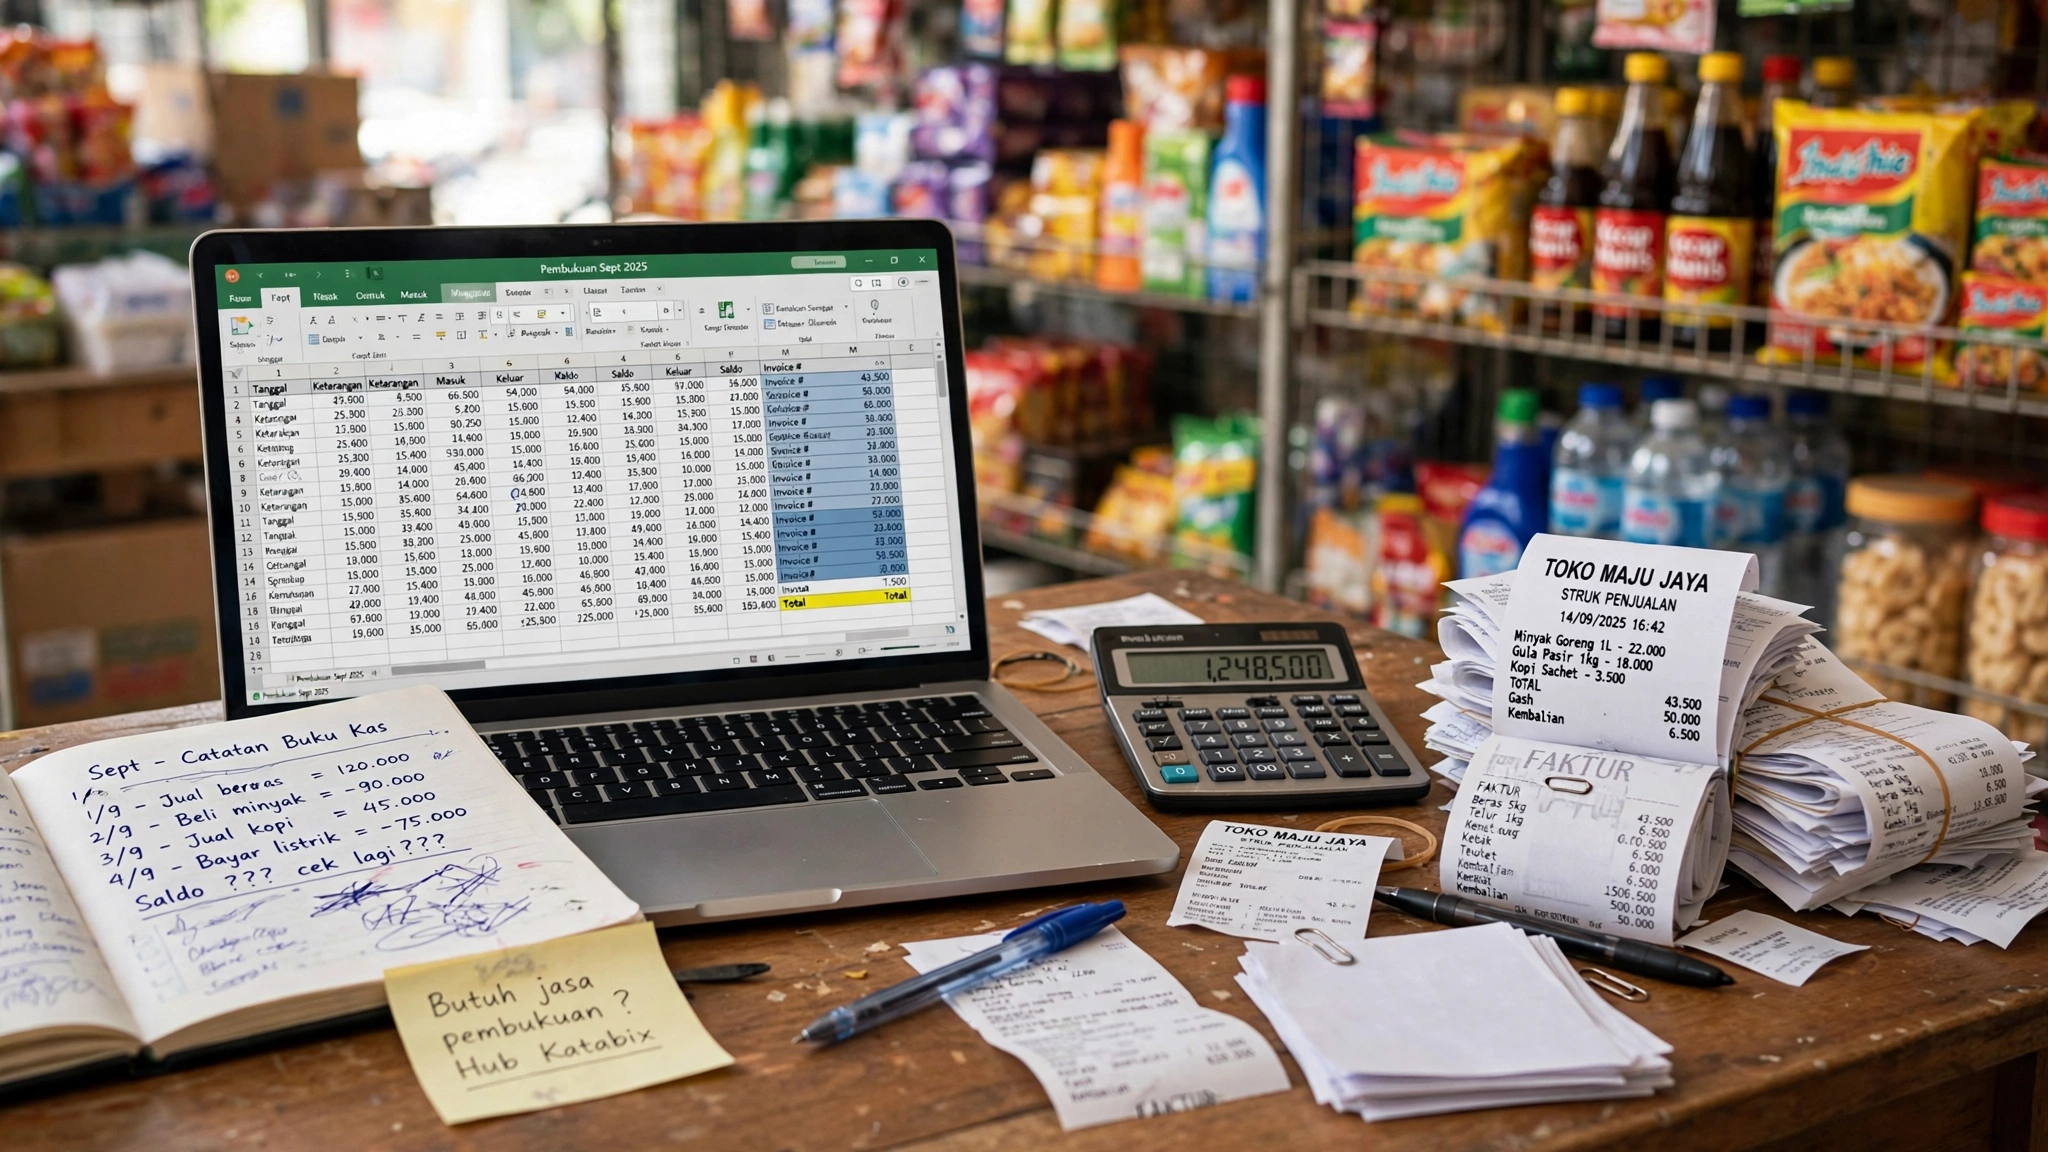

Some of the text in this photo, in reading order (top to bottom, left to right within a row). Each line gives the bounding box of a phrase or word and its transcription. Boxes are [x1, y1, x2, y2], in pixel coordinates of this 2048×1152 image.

[541, 262, 647, 274] Pembukuan Sept 2025
[253, 363, 794, 396] Tanggal Masuk Keluar Saldo Keluar Saldo Invoice
[769, 418, 799, 427] Invoice
[240, 519, 251, 527] 11
[773, 488, 805, 497] Invoice
[240, 504, 250, 512] 10
[776, 515, 807, 524] Invoice
[1545, 558, 1709, 593] TOKO MAJU JAYA
[783, 591, 907, 609] Total Total
[1561, 588, 1677, 612] STRUK PENJUALAN
[1560, 611, 1665, 633] 14/09/2025 16:42
[1514, 630, 1551, 645] Minyak
[1556, 635, 1594, 651] Goreng
[1600, 640, 1612, 651] 1L
[1628, 643, 1666, 657] 22.000
[1206, 655, 1323, 683] 1,248,500
[1512, 646, 1537, 659] Gula
[1543, 649, 1573, 663] Pasir
[1580, 653, 1599, 668] 1kg
[1617, 658, 1653, 671] 18.000
[1510, 661, 1535, 676] Kopi
[1542, 664, 1578, 680] Sachet
[1595, 671, 1625, 684] 3.500
[1509, 692, 1702, 710] Gash 43.500
[1199, 721, 1208, 729] 7
[1508, 707, 1700, 726] Kembalian 50.000
[1669, 727, 1700, 742] 6.500
[88, 759, 140, 780] Sept
[182, 743, 268, 764] Catatan
[282, 731, 338, 749] Buku
[349, 722, 387, 737] Kas
[1176, 767, 1185, 775] 0
[1256, 764, 1276, 772] 00
[1523, 749, 1635, 782] FAKTUR
[87, 804, 121, 825] 1/9
[160, 788, 203, 808] Jual
[338, 753, 409, 775] 120.000
[1477, 781, 1521, 798] FAKTUR
[1472, 795, 1526, 813] Beras 5kg
[90, 825, 132, 845] 2/9
[175, 809, 217, 827] Beli
[232, 793, 306, 816] minyak
[101, 847, 143, 866] 3/9
[185, 828, 234, 849] Jual
[247, 817, 294, 836] kopi
[363, 792, 435, 814] 45.000
[1470, 806, 1670, 838] Telur 1kg 6.500
[1638, 815, 1673, 827] 43.500
[1224, 825, 1269, 837] TOKO
[1273, 831, 1320, 843] MAJU
[1324, 836, 1367, 847] JAYA
[109, 867, 154, 890] 4/9
[196, 849, 260, 869] Bayar
[274, 831, 341, 854] listrik
[1632, 850, 1663, 863] 6.500
[1629, 862, 1660, 876] 6.000
[135, 886, 204, 911] Saldo
[298, 858, 339, 876] cek
[1627, 876, 1658, 890] 6.500
[1457, 882, 1655, 916] Kembalian 500.000
[428, 975, 594, 1018] Butuh jasa
[442, 989, 630, 1054] pembukuan ?
[455, 1028, 656, 1081] Hub Katabix
